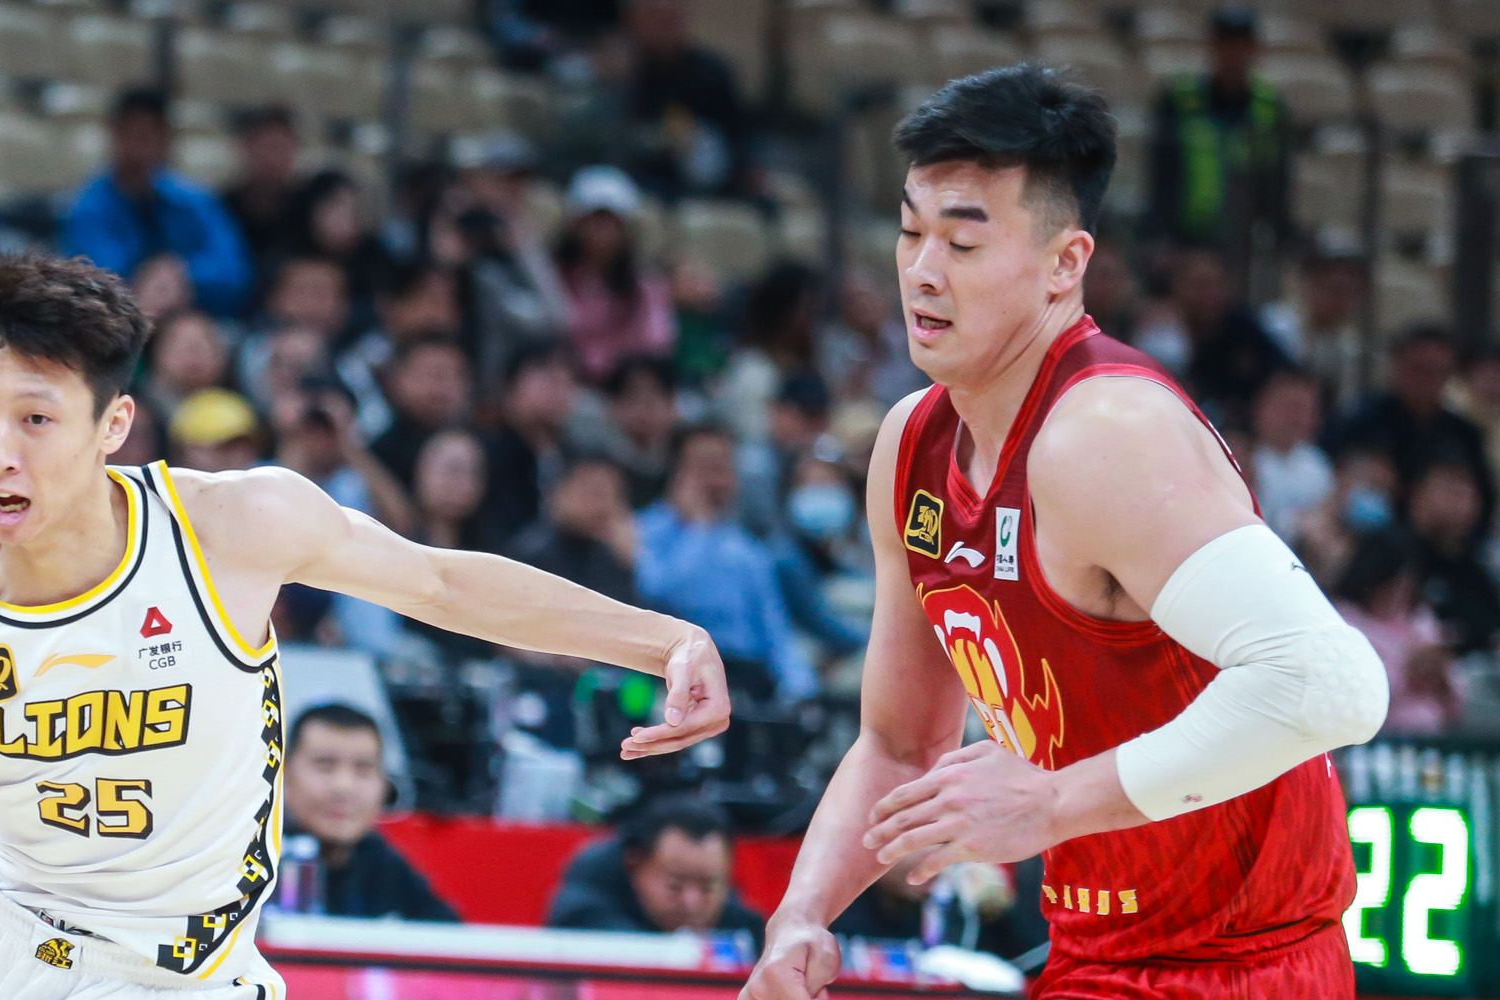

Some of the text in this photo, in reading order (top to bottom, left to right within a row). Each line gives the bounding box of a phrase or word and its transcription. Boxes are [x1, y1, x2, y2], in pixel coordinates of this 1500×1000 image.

[138, 640, 182, 659] 广发银行
[149, 655, 176, 670] CGB
[37, 777, 154, 840] 25
[1342, 806, 1471, 977] 22
